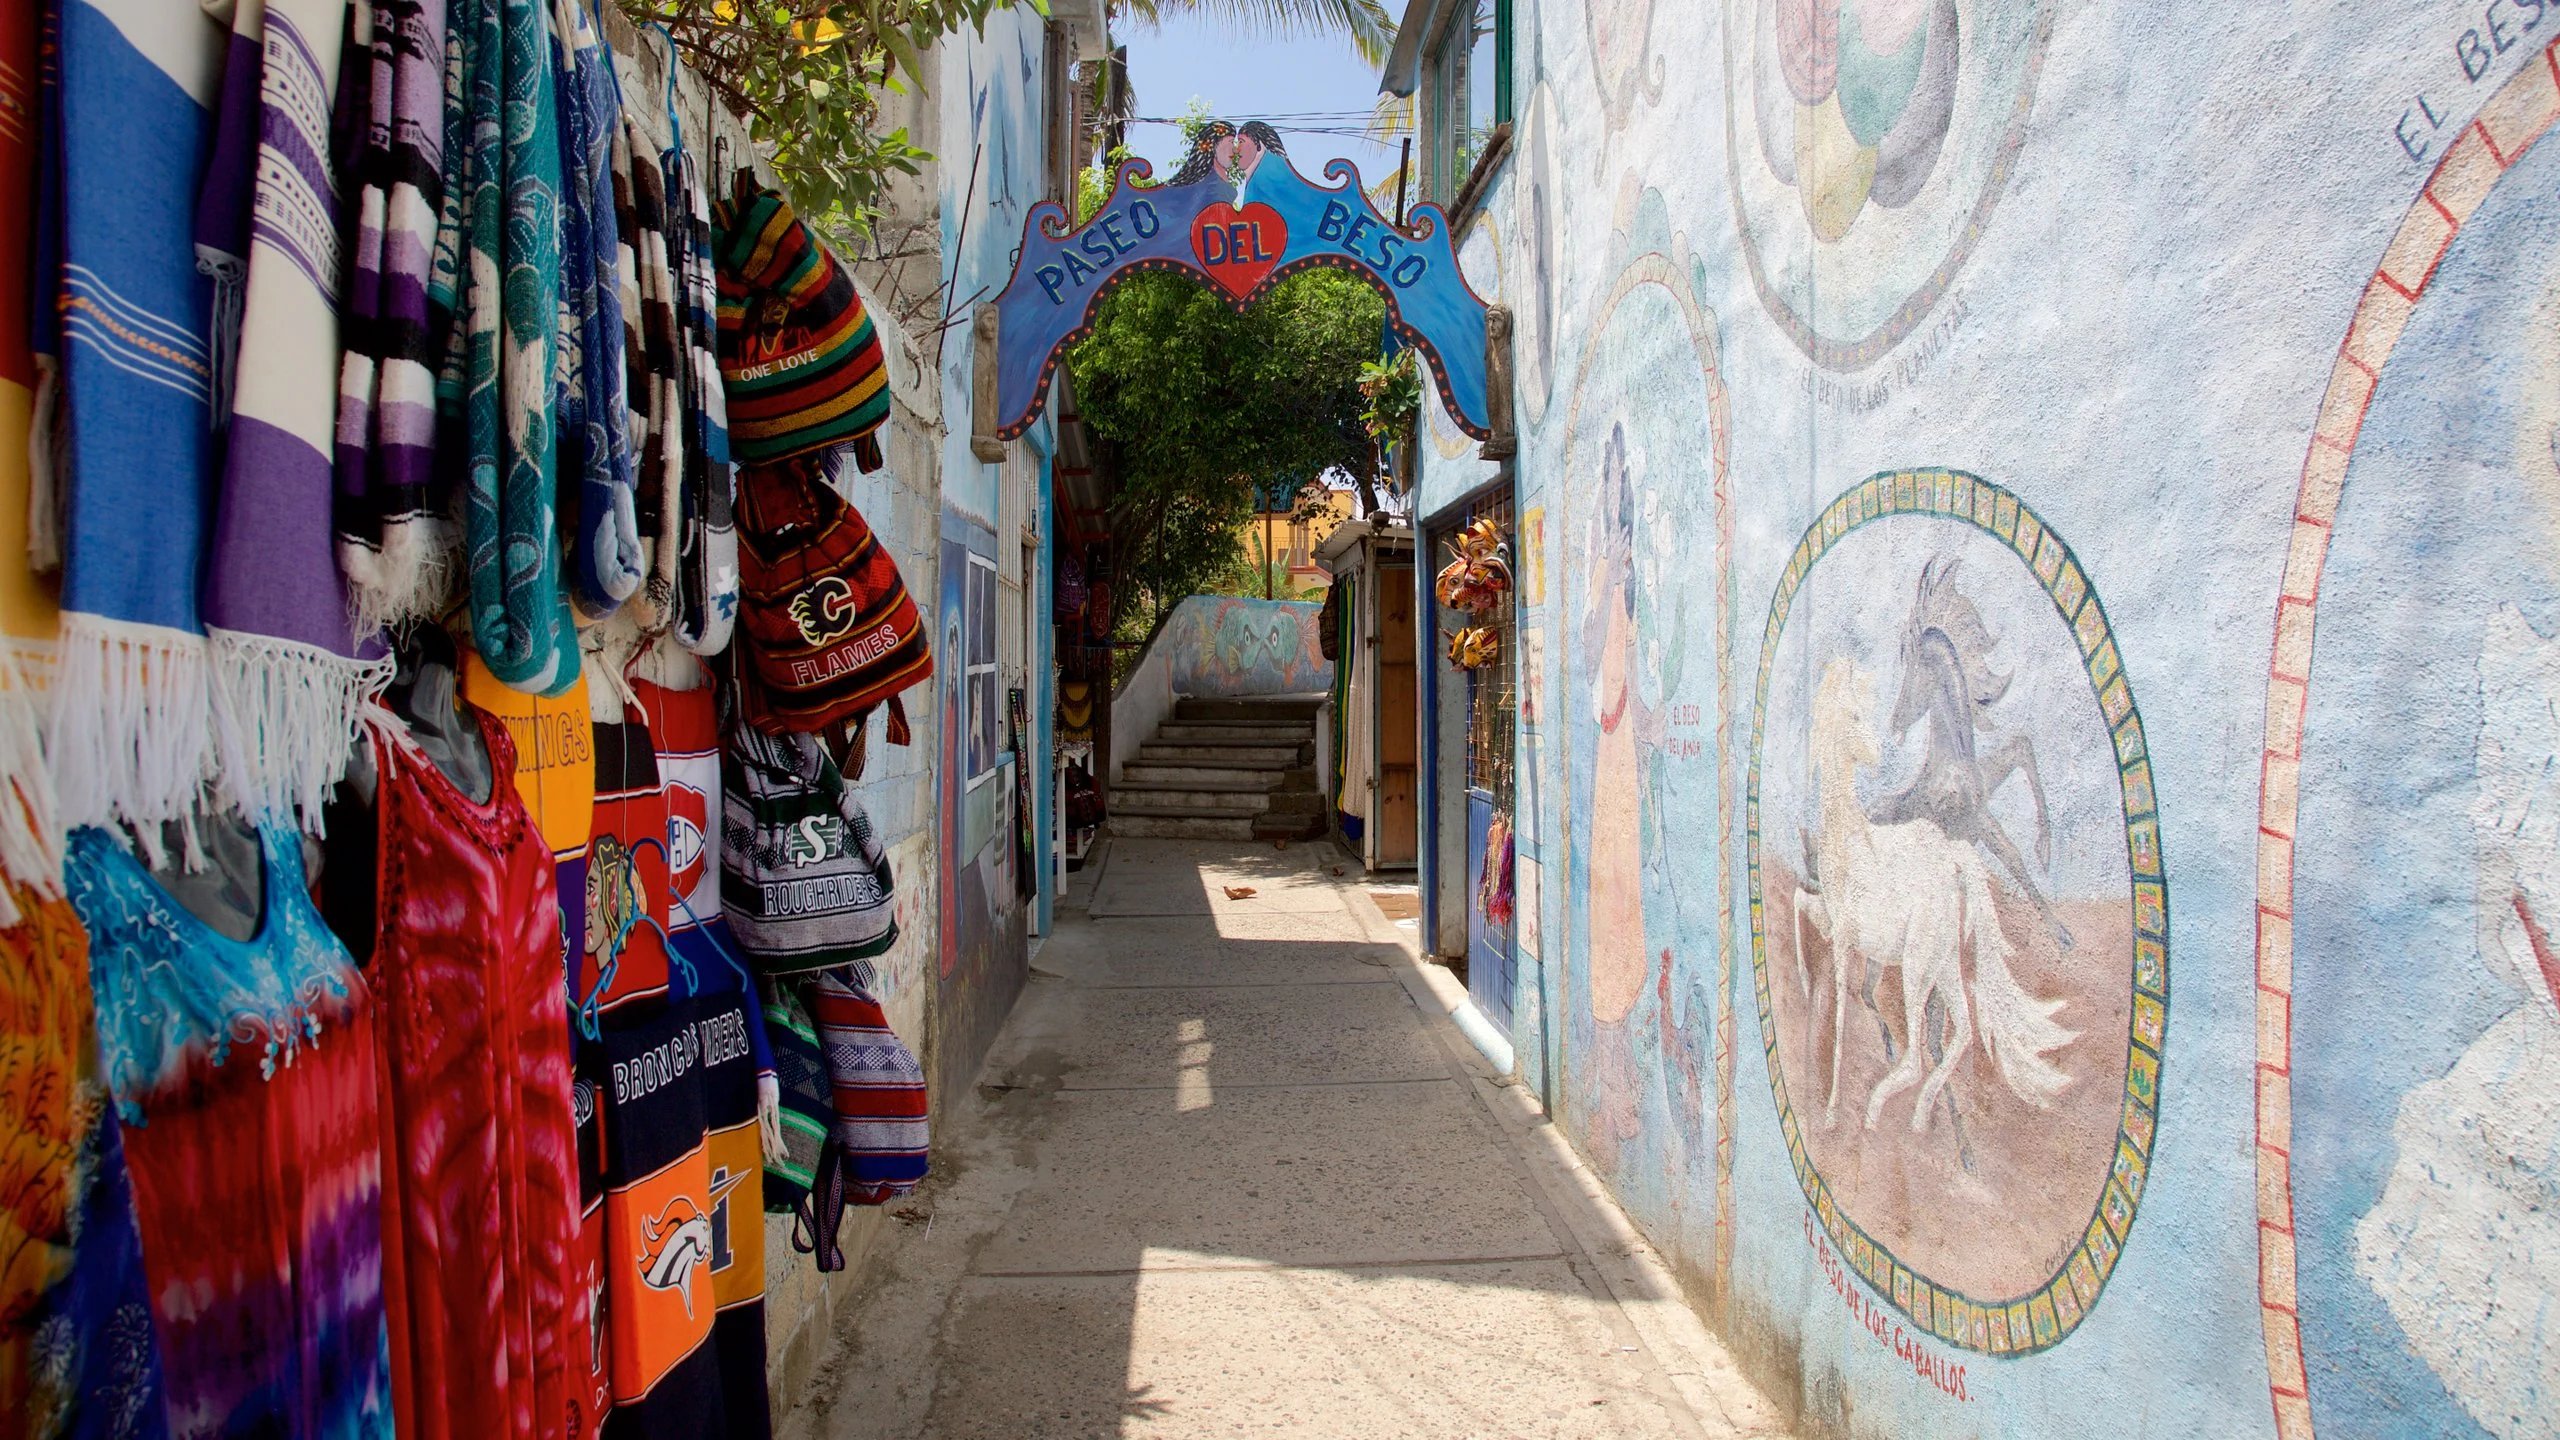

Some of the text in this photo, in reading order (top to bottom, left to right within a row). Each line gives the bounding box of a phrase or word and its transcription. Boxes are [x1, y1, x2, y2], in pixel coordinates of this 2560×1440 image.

[2395, 0, 2558, 163] EL BES
[1034, 197, 1429, 305] PASEO DEL BESO
[740, 350, 819, 382] ONE LOVE
[791, 624, 899, 686] FLAMES
[1673, 704, 1700, 726] EL BESO
[1668, 737, 1680, 755] DEL
[763, 874, 883, 916] ROUGHRIDERS
[613, 1022, 700, 1105] BRONCOS
[699, 1008, 749, 1068] MBERS
[1804, 1209, 1815, 1248] EL
[1819, 1236, 1844, 1296] BESO
[1846, 1281, 1861, 1321] DE
[1865, 1299, 1889, 1348] LOS
